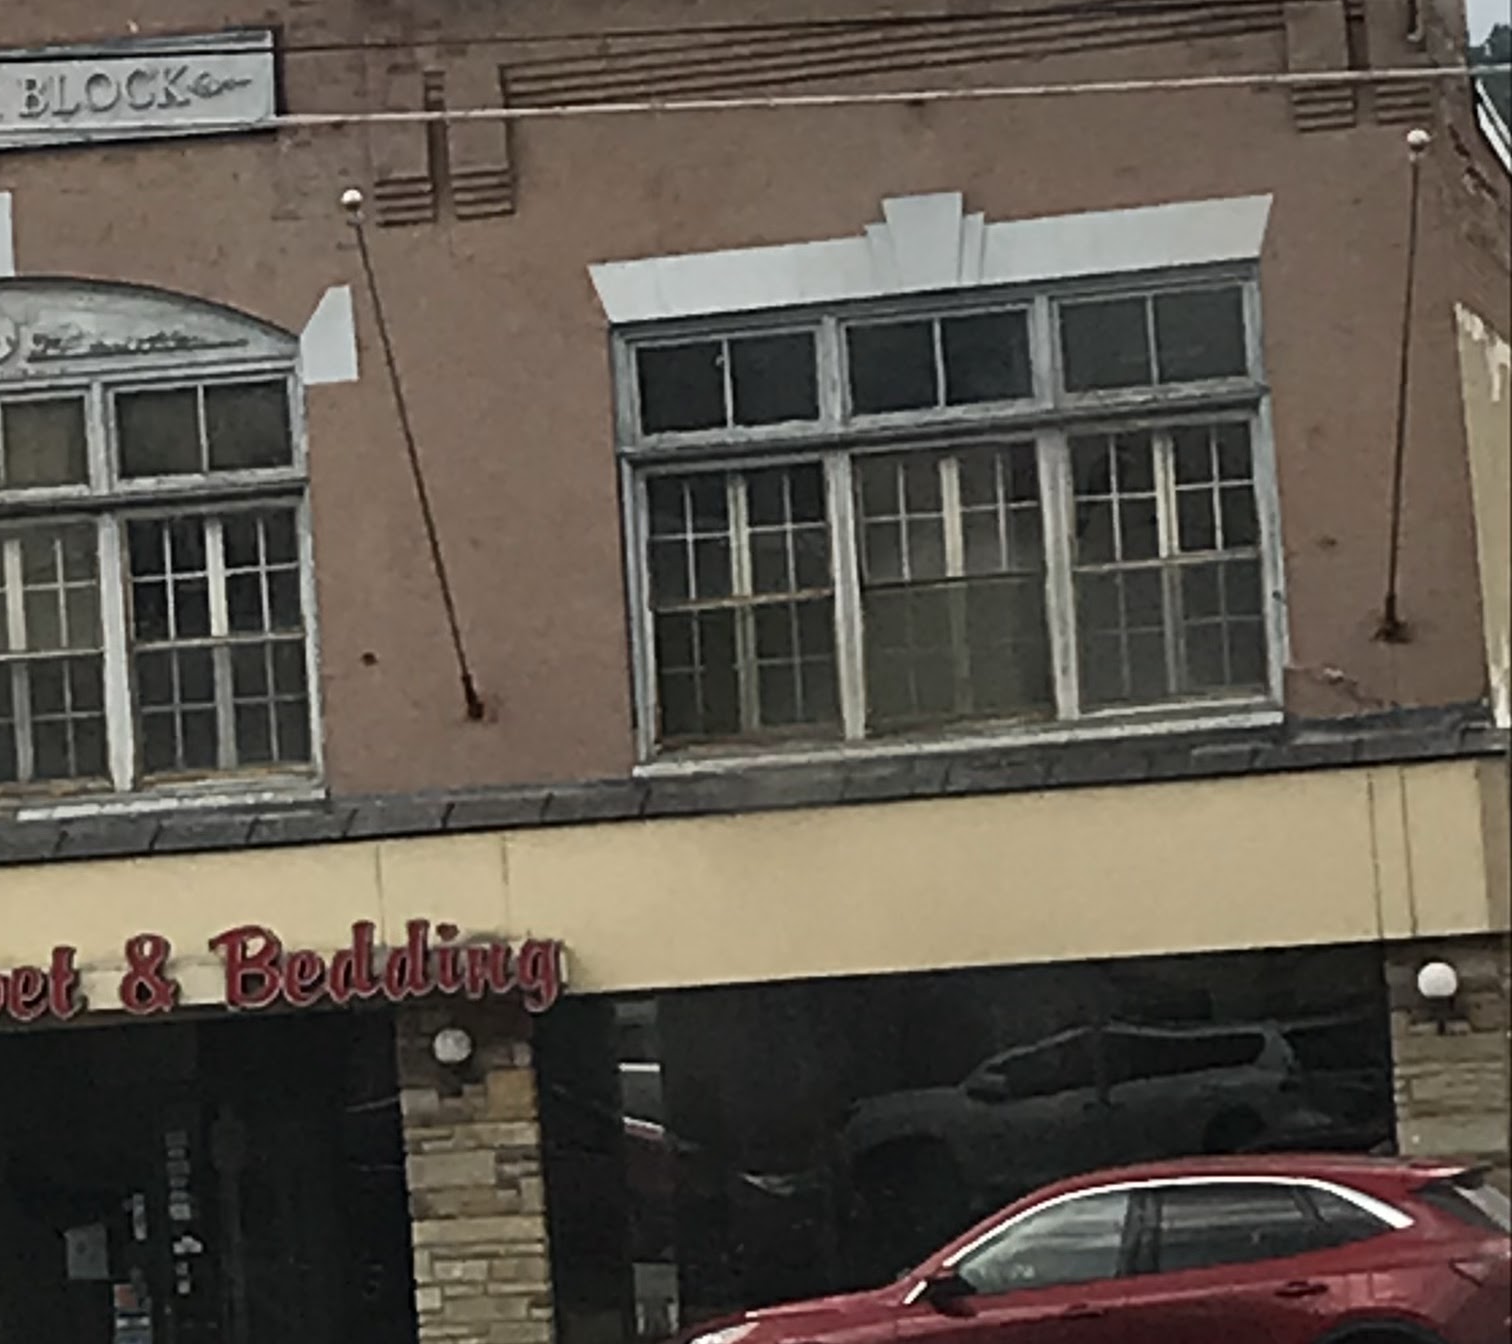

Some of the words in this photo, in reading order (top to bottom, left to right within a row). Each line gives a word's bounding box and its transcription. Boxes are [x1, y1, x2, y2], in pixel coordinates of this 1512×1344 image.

[17, 64, 191, 119] BLOCK
[118, 932, 179, 1014] &
[207, 917, 564, 1013] Bedding
